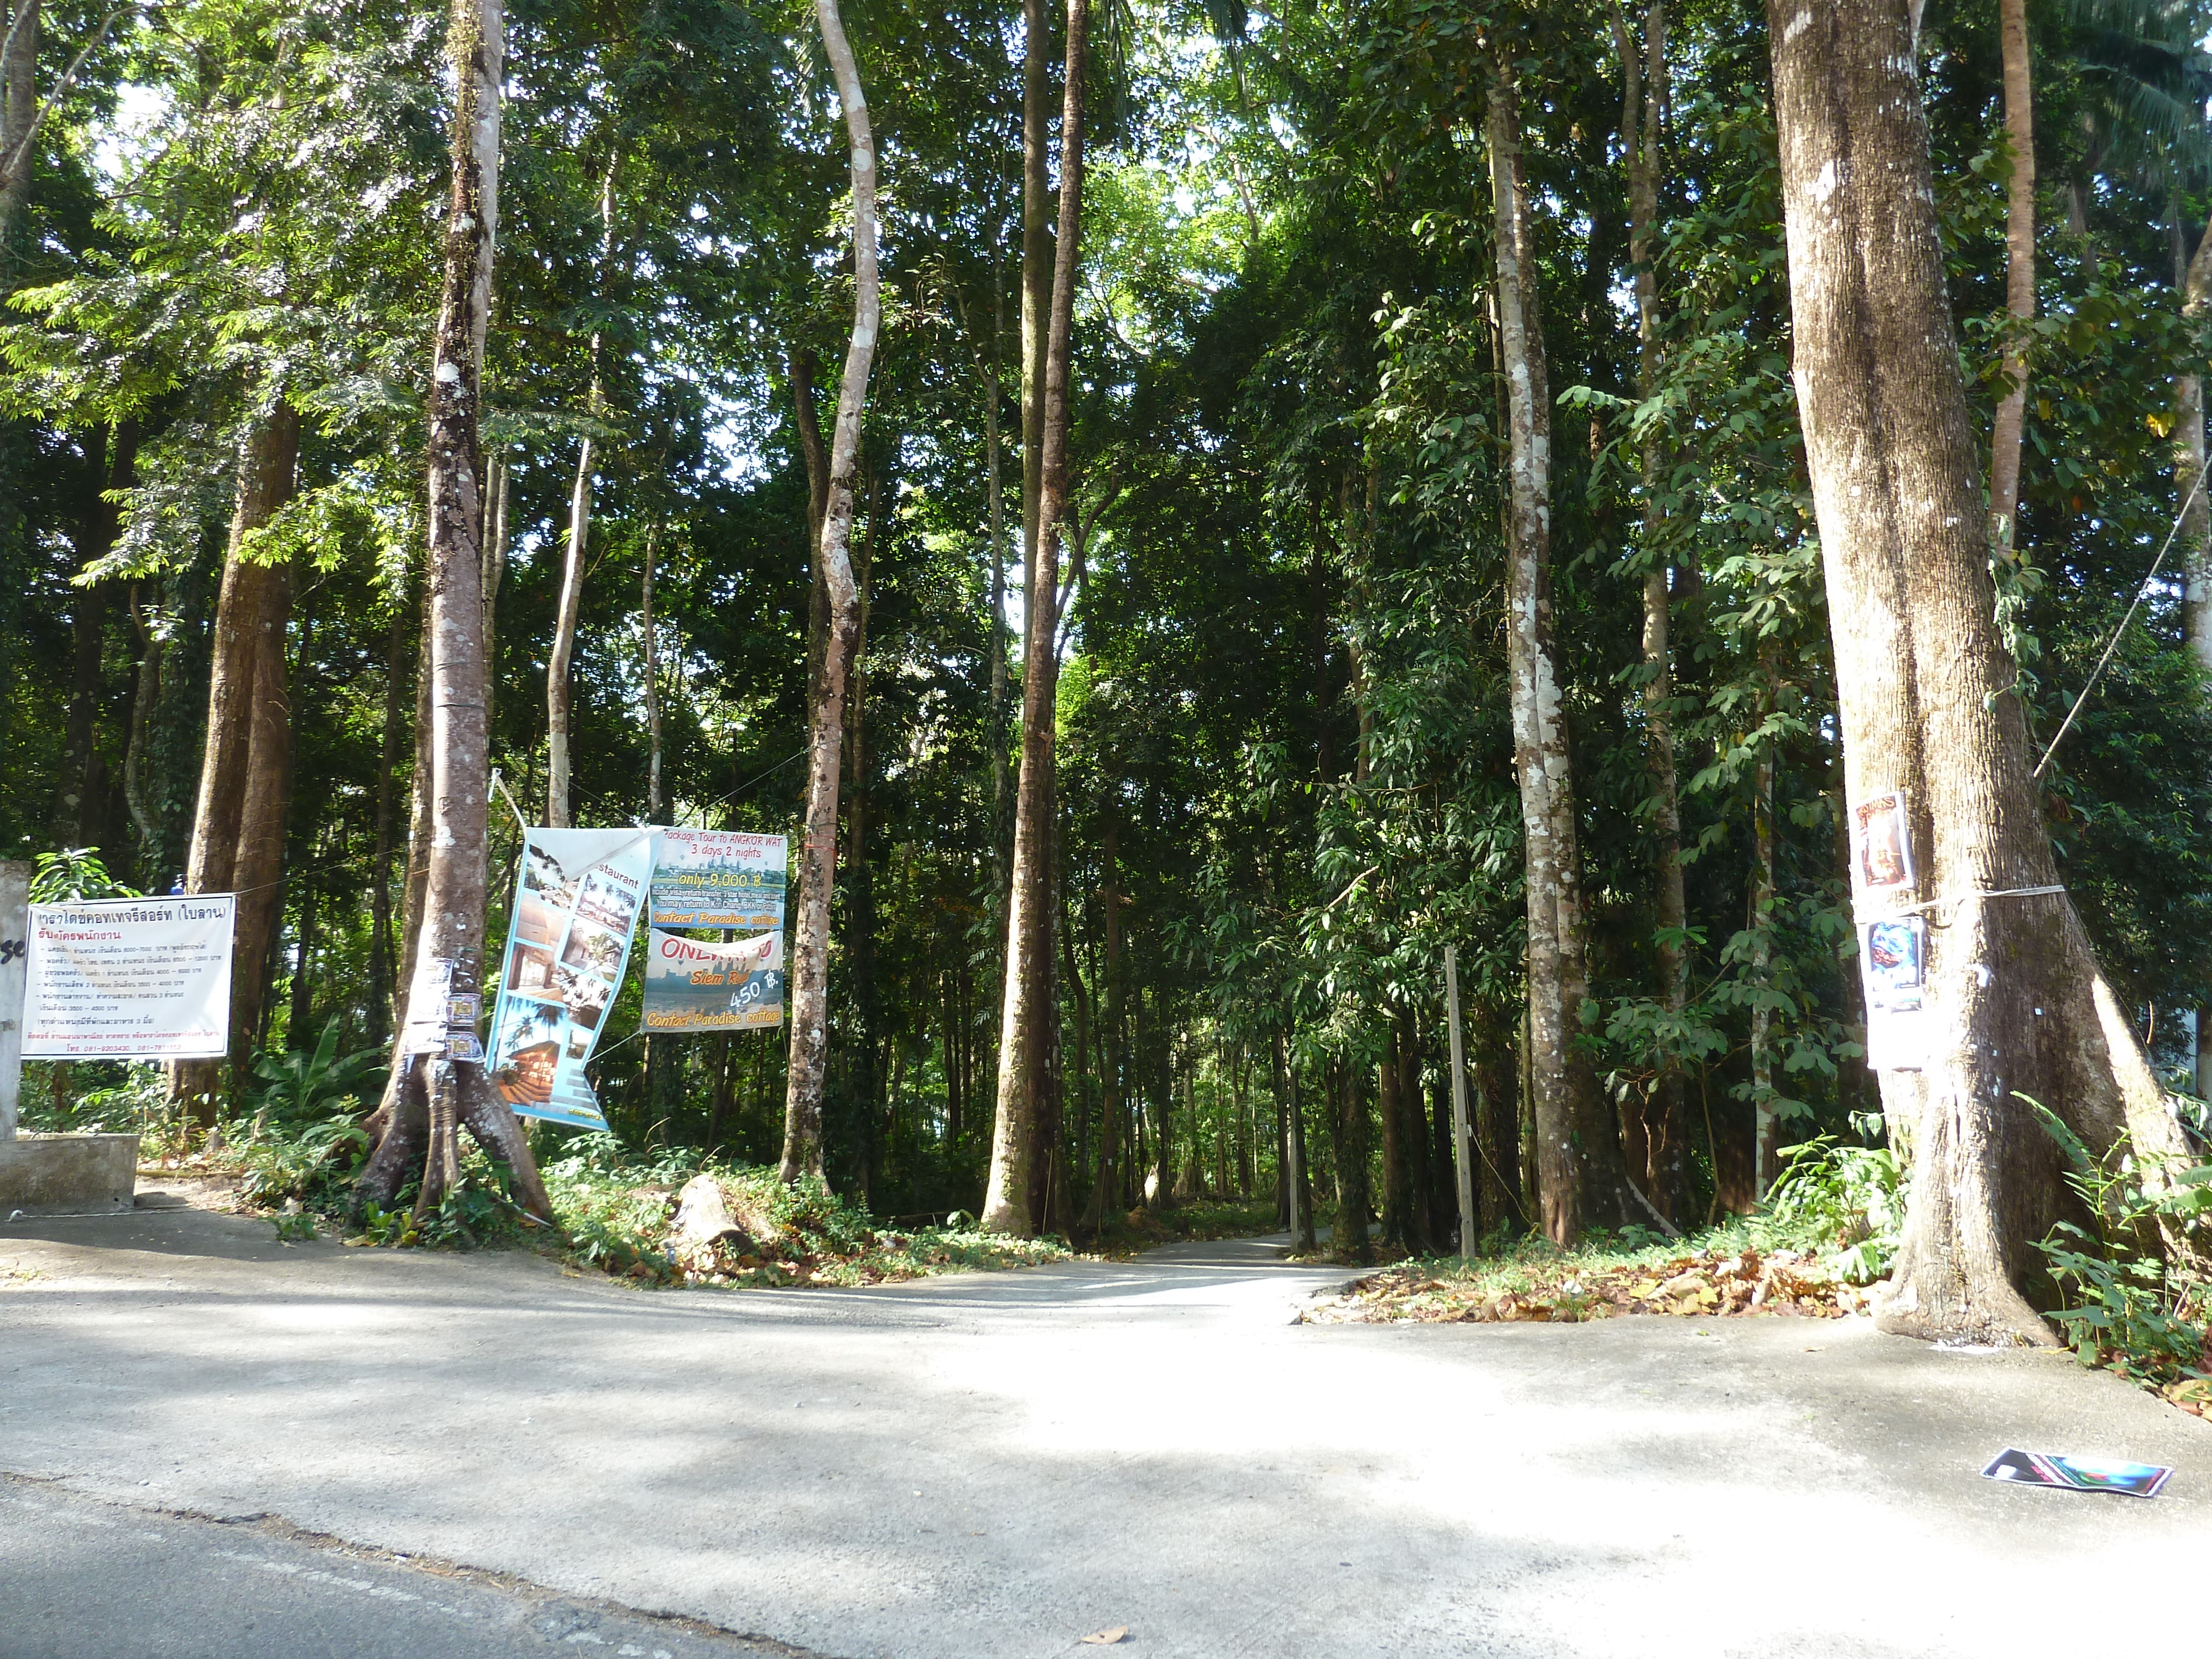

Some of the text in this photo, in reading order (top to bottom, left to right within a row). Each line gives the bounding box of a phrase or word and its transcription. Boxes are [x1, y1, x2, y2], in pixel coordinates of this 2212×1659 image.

[698, 832, 716, 842] Tour
[719, 832, 727, 843] to
[729, 834, 763, 846] ANGKOR
[765, 837, 783, 847] WAT
[691, 843, 761, 860] 3 days 2 nights
[678, 873, 705, 889] only
[657, 899, 666, 907] You
[668, 901, 682, 910] may
[684, 900, 702, 908] return
[743, 901, 756, 909] BKK
[653, 911, 696, 924] Contact
[698, 912, 747, 924] Paradise
[691, 971, 724, 985] Siem
[730, 982, 760, 1008] 450
[646, 1007, 780, 1027] Contact Paradise cottage
